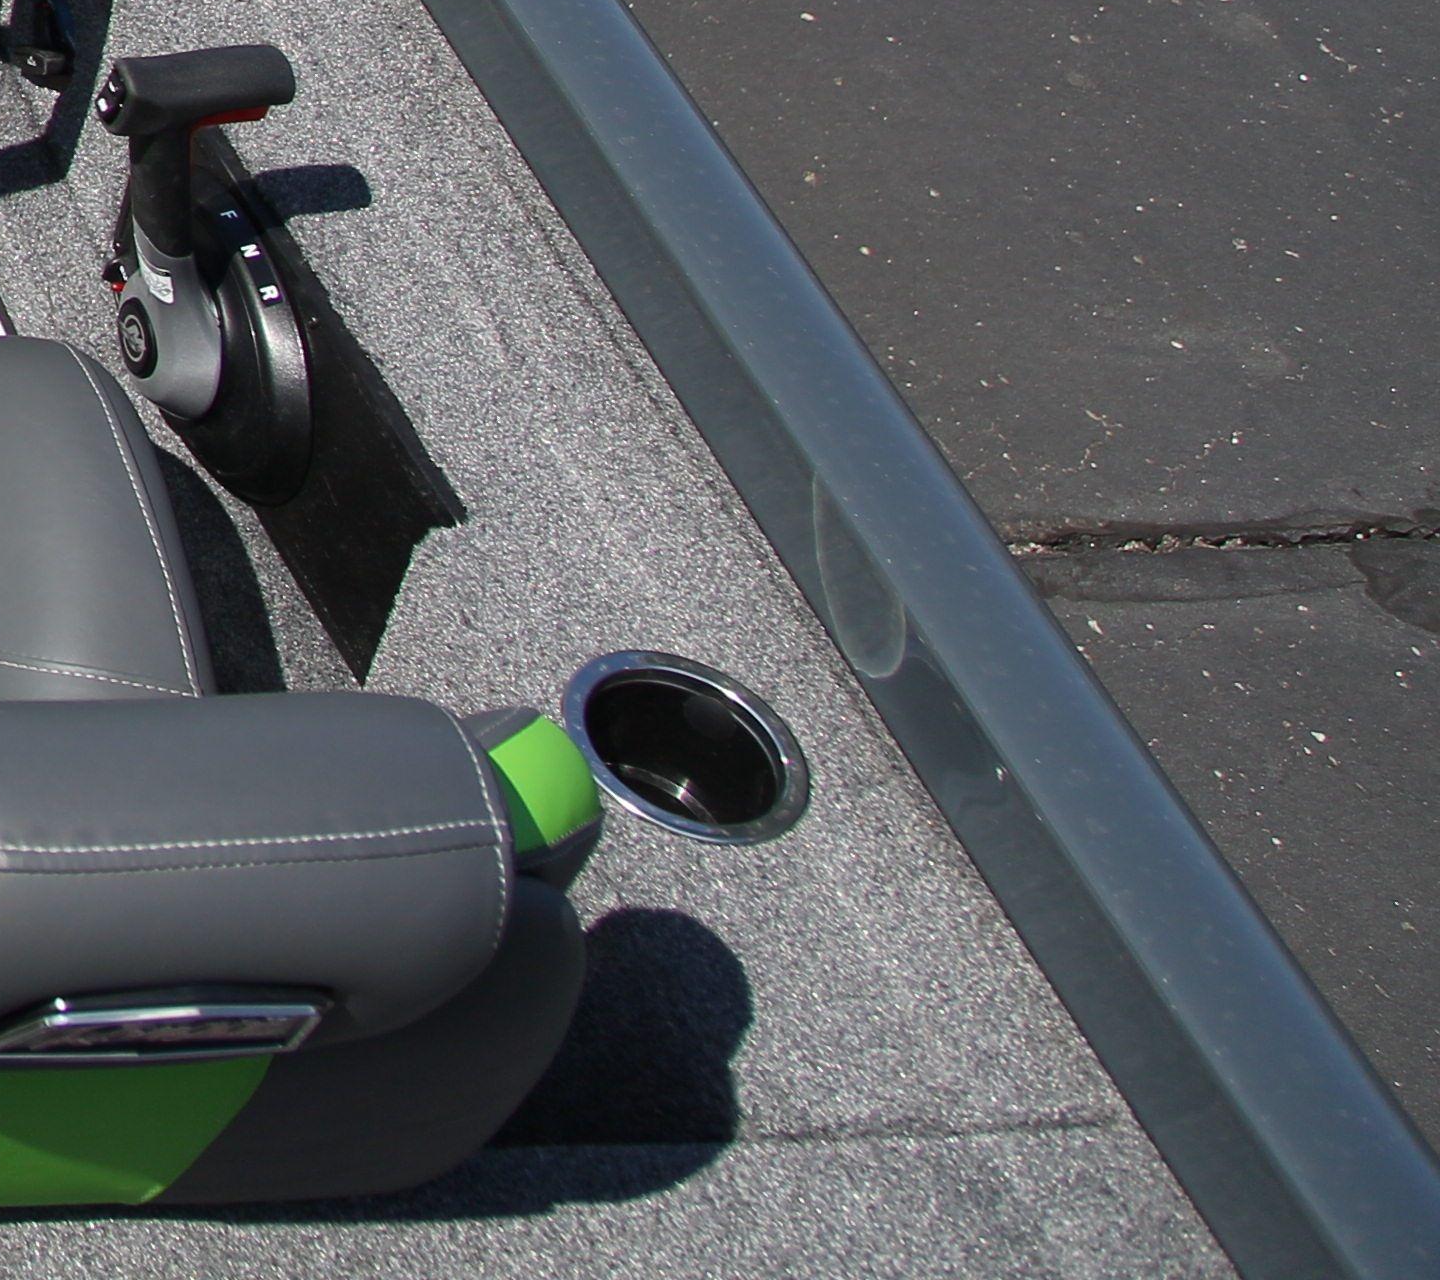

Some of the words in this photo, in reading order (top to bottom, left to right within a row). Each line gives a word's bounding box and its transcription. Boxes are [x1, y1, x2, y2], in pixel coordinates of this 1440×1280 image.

[220, 208, 239, 221] F
[240, 243, 260, 260] N
[258, 284, 282, 303] R
